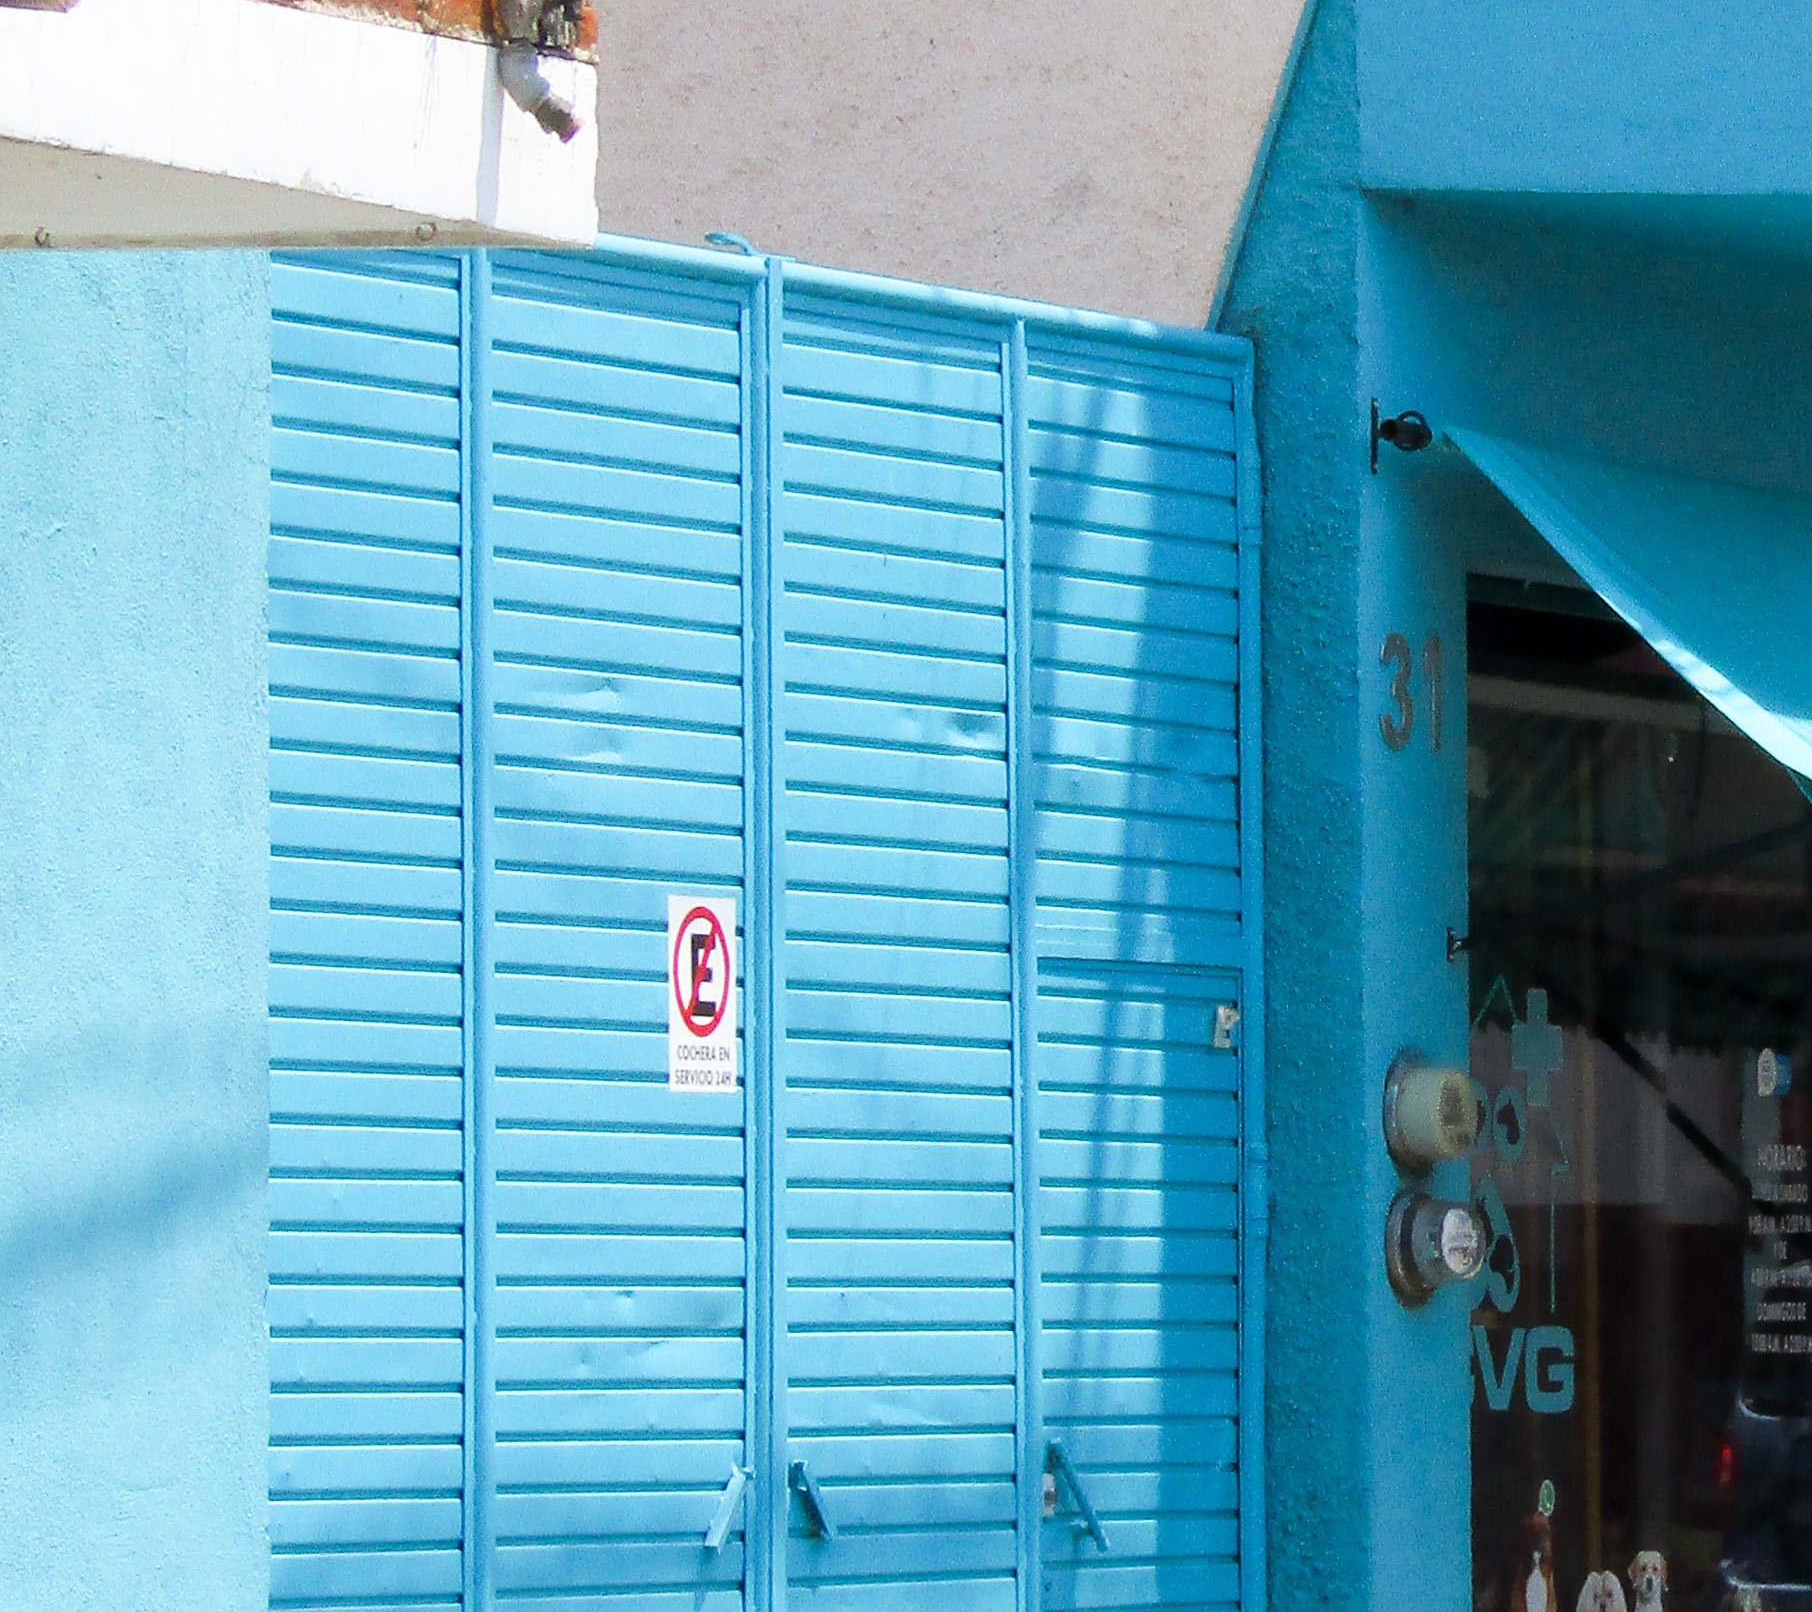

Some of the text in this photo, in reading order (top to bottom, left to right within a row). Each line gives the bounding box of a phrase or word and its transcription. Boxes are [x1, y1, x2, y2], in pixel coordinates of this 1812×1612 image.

[1380, 632, 1442, 752] 31
[675, 1069, 713, 1085] SERVICIO
[676, 1044, 731, 1062] COCHERA EN
[1472, 1323, 1576, 1413] VG
